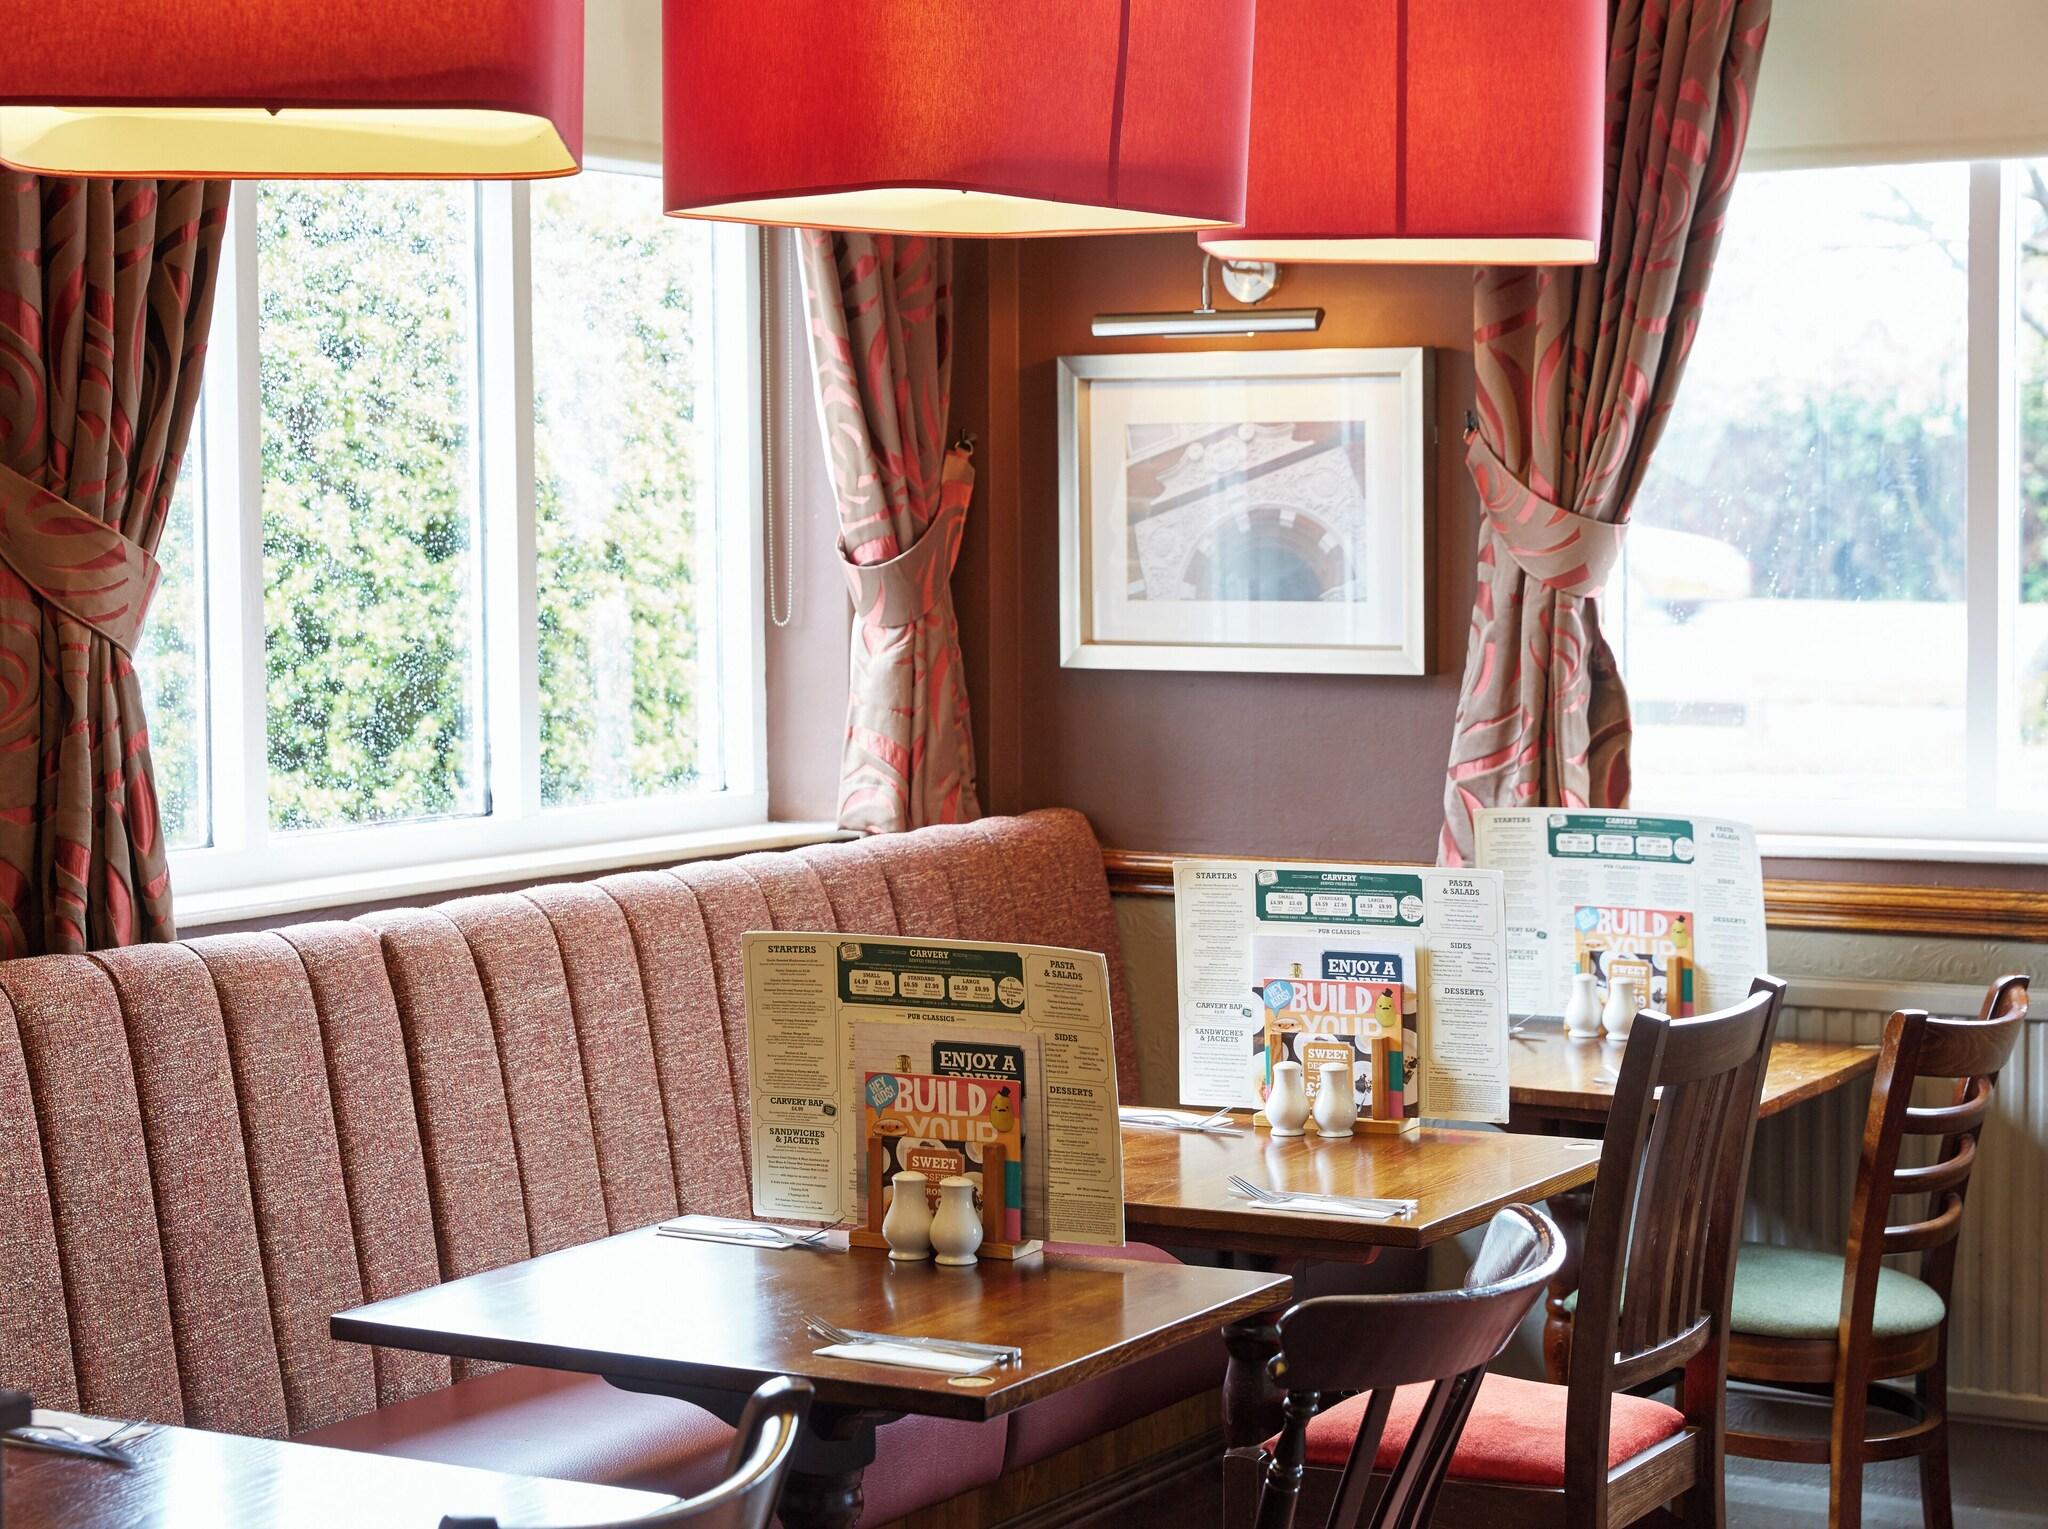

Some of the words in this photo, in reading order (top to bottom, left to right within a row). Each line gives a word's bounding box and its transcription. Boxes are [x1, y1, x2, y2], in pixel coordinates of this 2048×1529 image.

[1195, 872, 1237, 880] STARTERS
[1321, 873, 1357, 882] CARVERY
[1448, 879, 1473, 887] PASTA
[1450, 888, 1480, 897] SALADS
[1597, 908, 1668, 938] BUILD
[1712, 916, 1746, 925] DESSERTS
[767, 945, 817, 954] STARTERS
[1450, 942, 1472, 950] SIDES
[909, 949, 949, 959] CARVERY
[1050, 960, 1076, 970] PASTA
[1327, 958, 1380, 976] ENJOY
[1381, 961, 1396, 975] A
[1044, 969, 1050, 977] &
[1051, 970, 1083, 981] SALADS
[1444, 987, 1485, 997] DESSERTS
[1289, 982, 1373, 1015] BUILD
[1195, 1002, 1228, 1010] CARVERY
[923, 1014, 955, 1022] CLASSICS
[1054, 1033, 1078, 1042] SIDES
[1195, 1028, 1244, 1037] SANDWICHES
[1206, 1035, 1239, 1044] JACKETS
[1308, 1048, 1348, 1060] SWEET
[939, 1050, 999, 1071] ENJOY
[1002, 1055, 1017, 1071] A
[868, 1076, 887, 1096] HEY
[1049, 1085, 1093, 1097] DESSERTS
[871, 1084, 896, 1107] KIDS!
[894, 1077, 987, 1117] BUILD
[770, 1097, 807, 1106] CARVERY
[808, 1098, 824, 1107] BAP
[769, 1127, 825, 1138] SANDWICHES
[784, 1136, 820, 1145] JACKETS
[911, 1155, 958, 1170] SWEET
